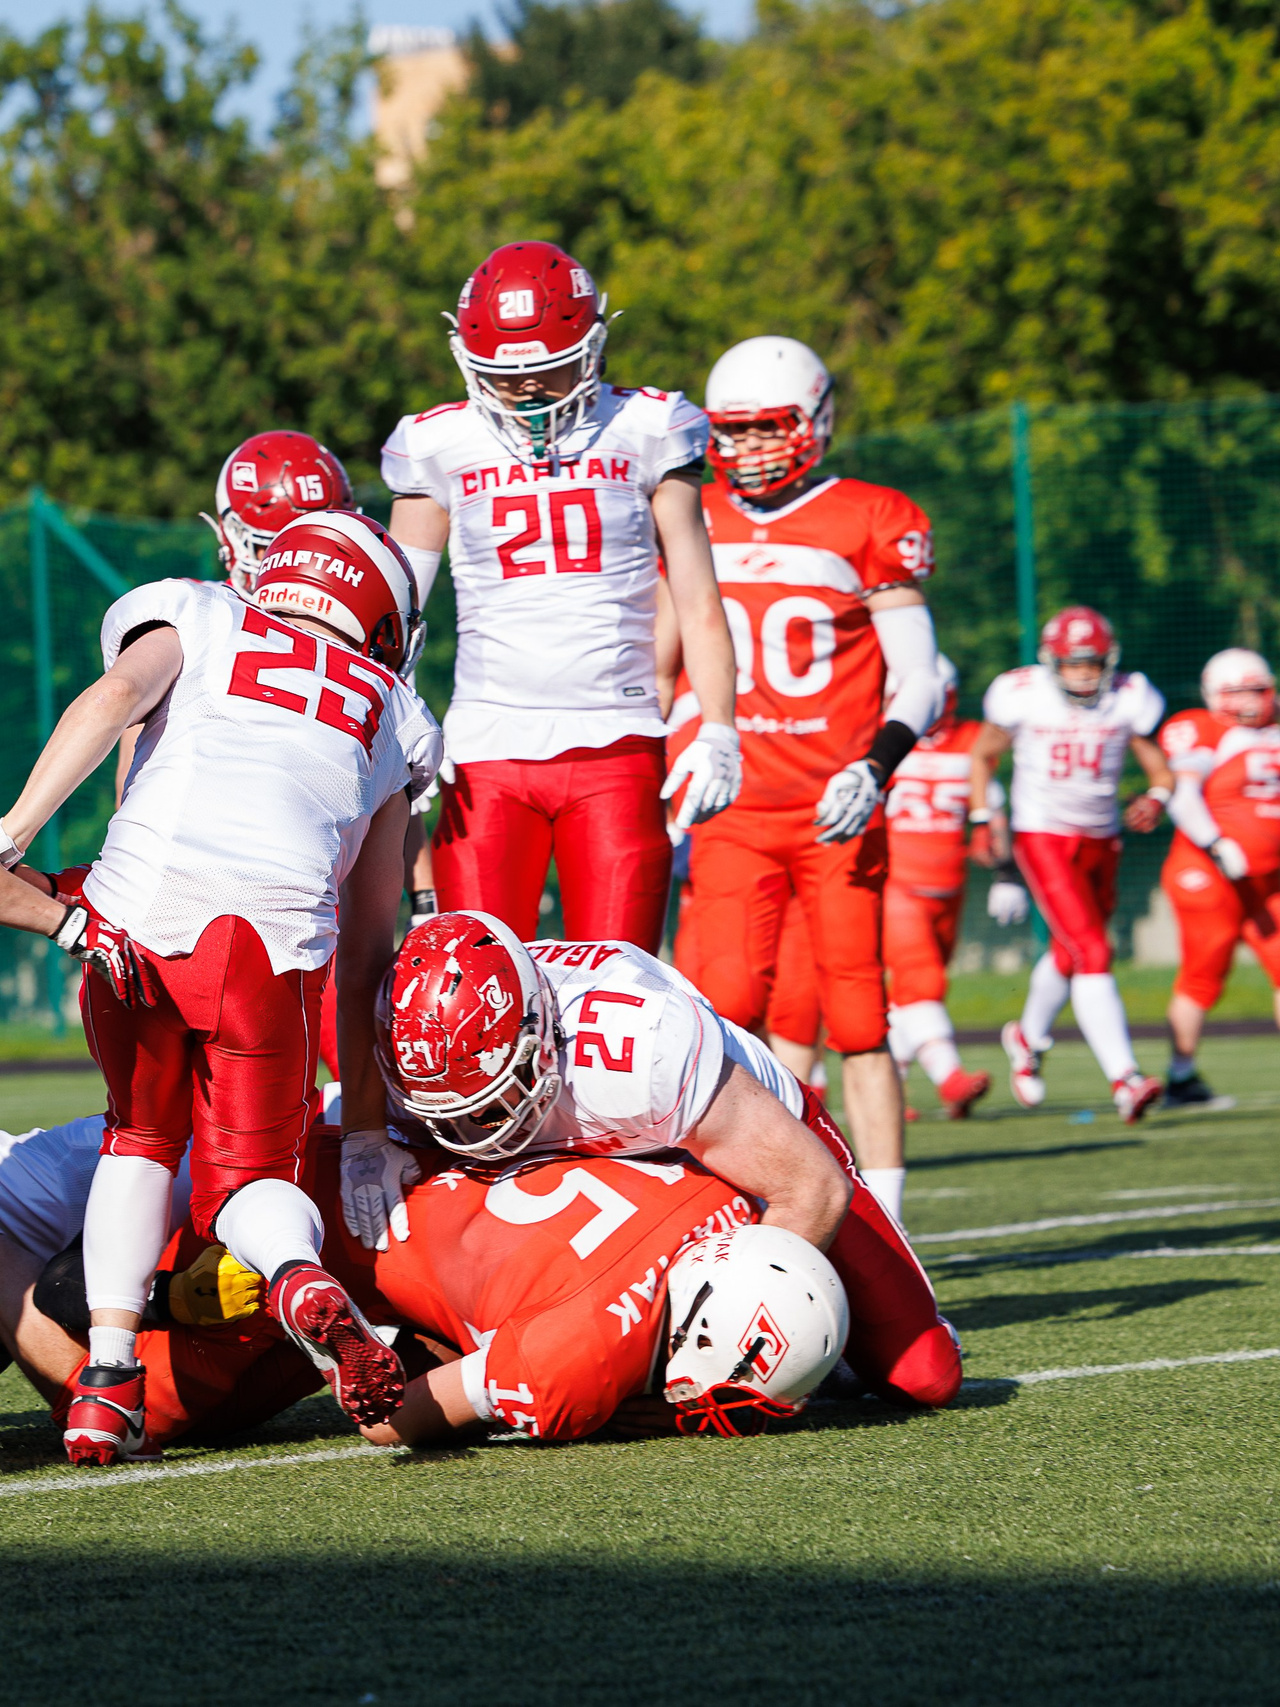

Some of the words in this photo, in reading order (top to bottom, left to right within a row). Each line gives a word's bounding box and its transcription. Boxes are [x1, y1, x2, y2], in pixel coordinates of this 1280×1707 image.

[498, 289, 534, 320] 20
[295, 474, 325, 502] 15
[491, 488, 602, 580] 20
[258, 549, 365, 588] СПАРТАК
[258, 588, 333, 615] Riddell
[227, 606, 396, 762] 25
[1050, 742, 1104, 780] 94
[528, 944, 624, 971] AGAL
[574, 989, 646, 1073] 27
[396, 1040, 435, 1071] 27
